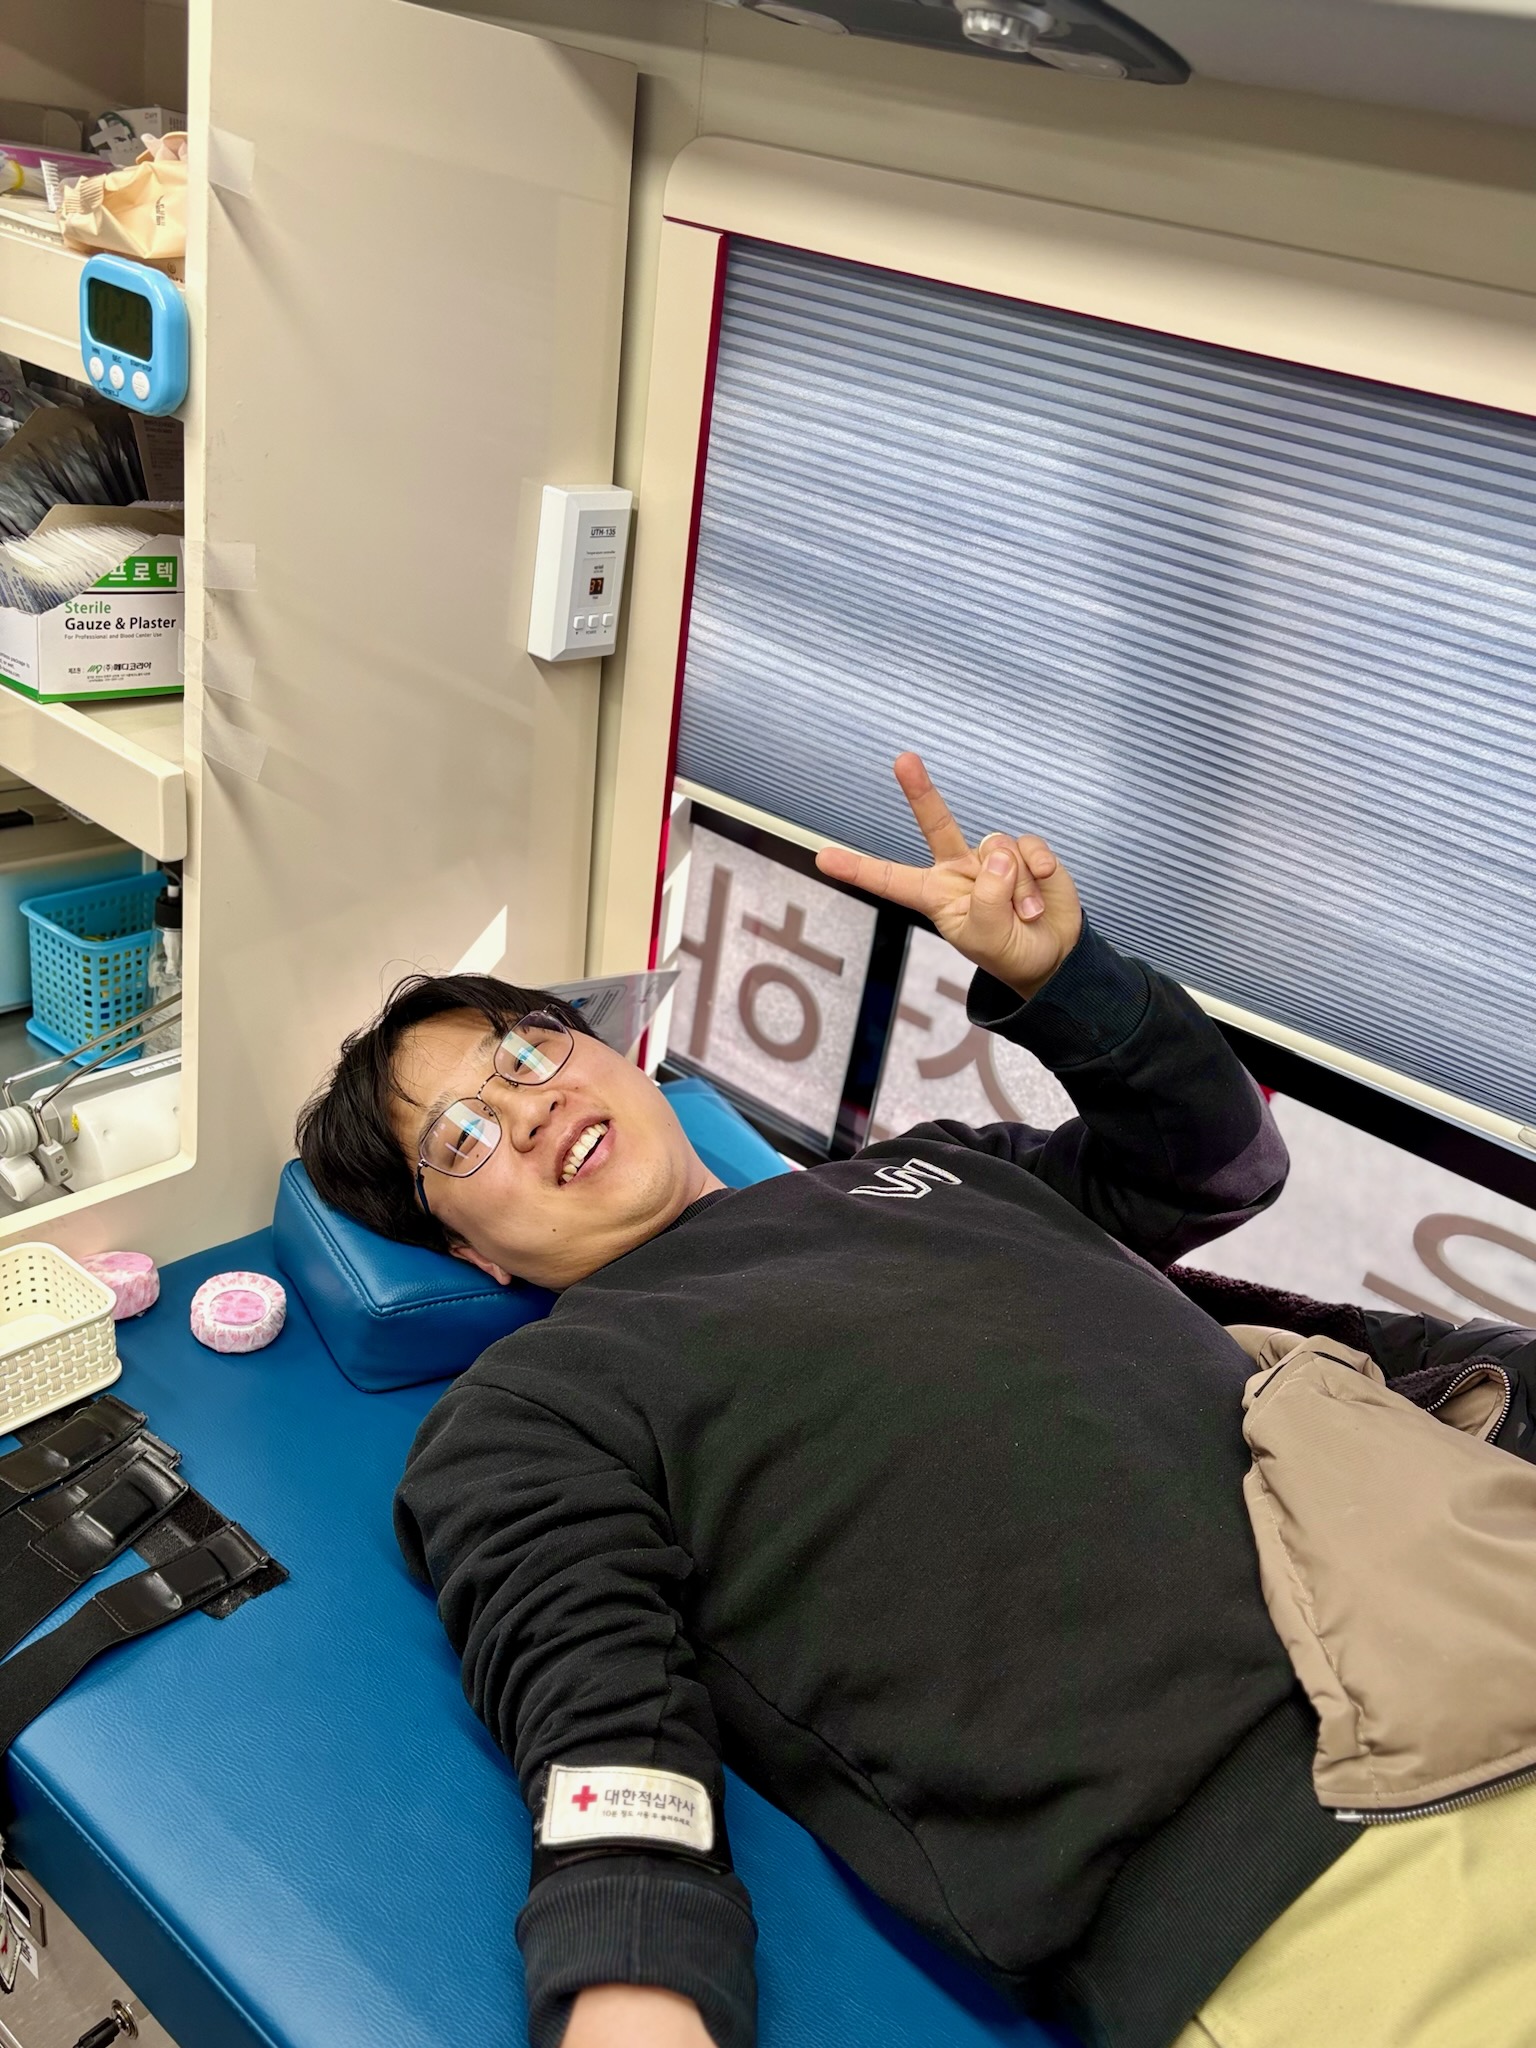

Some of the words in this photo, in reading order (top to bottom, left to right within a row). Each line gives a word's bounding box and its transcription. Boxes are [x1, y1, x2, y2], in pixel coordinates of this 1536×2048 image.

[591, 528, 616, 537] UTH-135
[108, 562, 173, 582] 프로텍
[65, 601, 111, 614] Sterile
[65, 617, 111, 630] Gauze
[115, 617, 126, 630] &
[129, 616, 177, 630] Plaster
[604, 1789, 696, 1817] 대한적십자사
